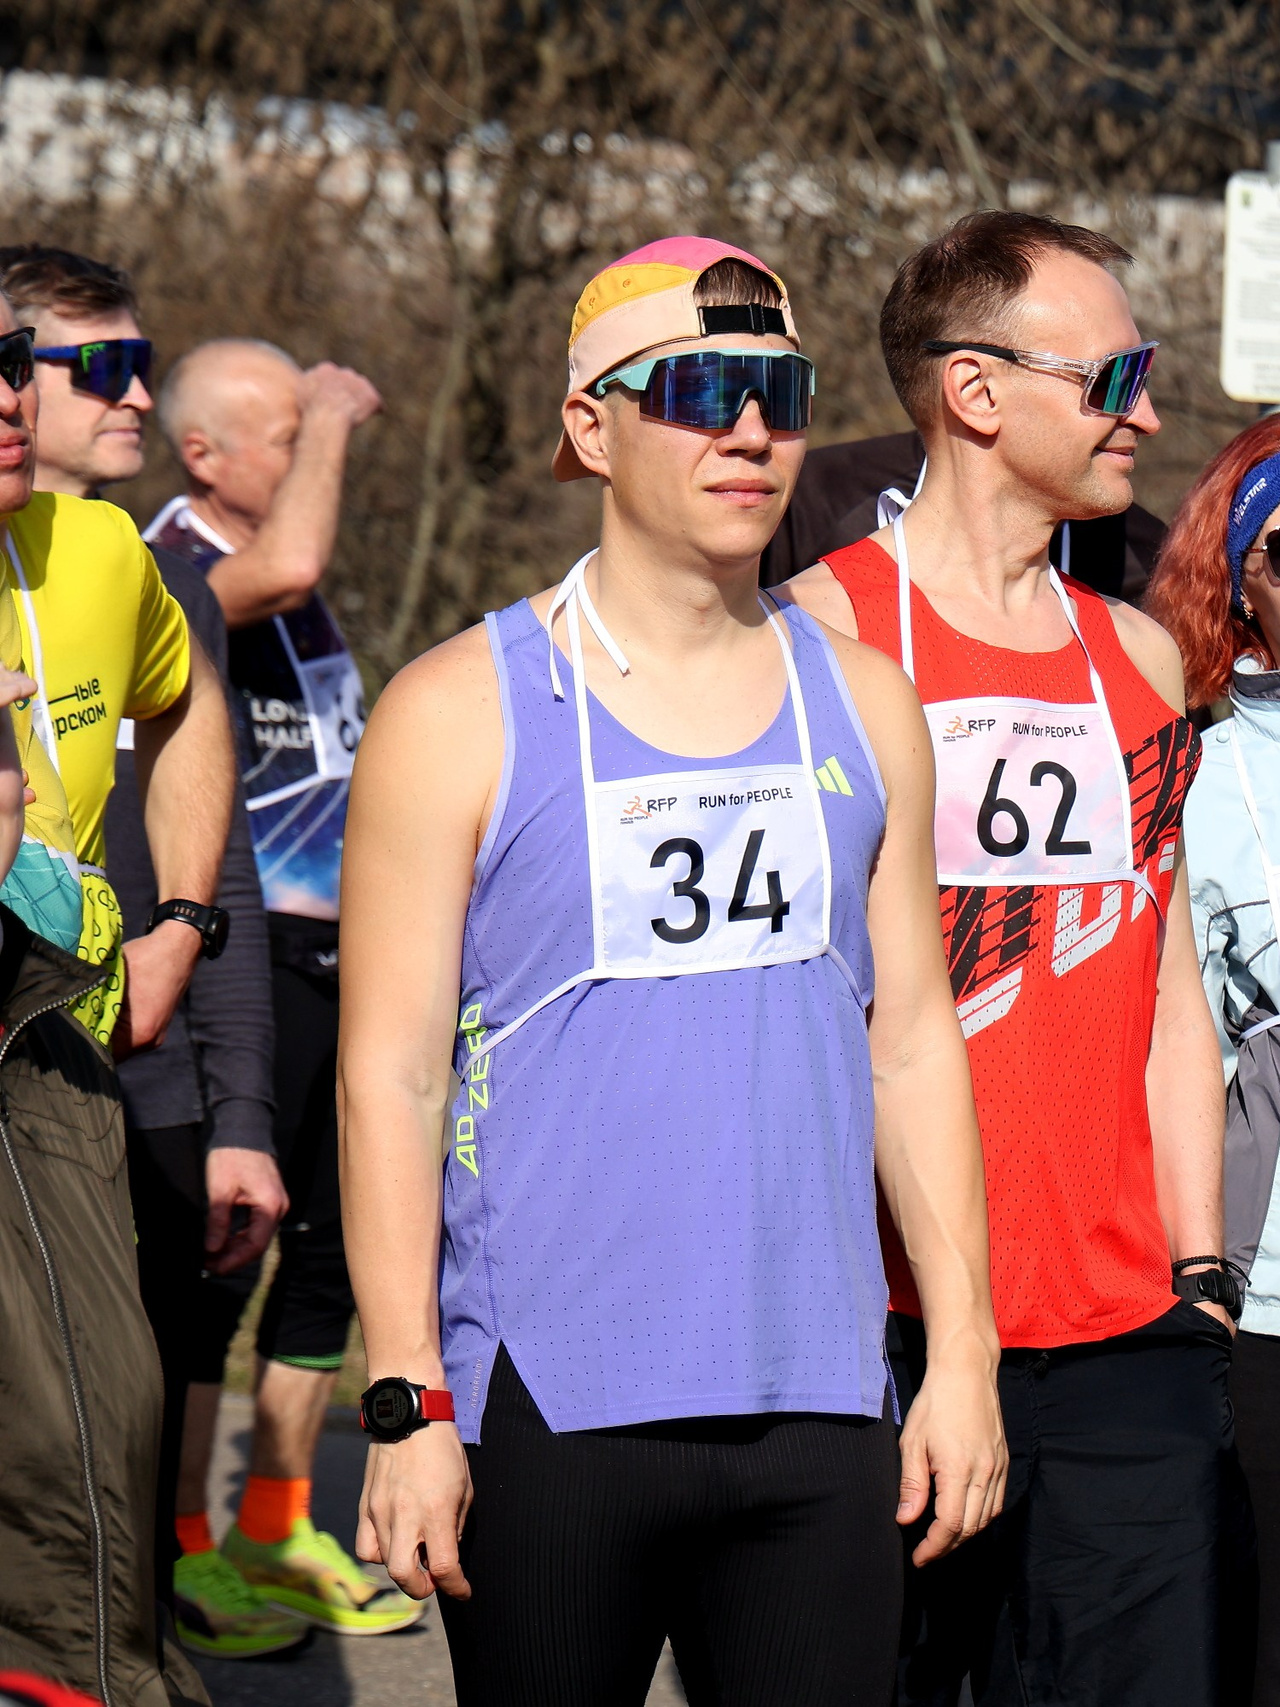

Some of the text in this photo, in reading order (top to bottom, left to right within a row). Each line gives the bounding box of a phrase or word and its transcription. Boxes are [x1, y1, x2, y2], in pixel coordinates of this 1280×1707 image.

[52, 702, 107, 741] рском
[968, 719, 996, 732] RFP
[1012, 722, 1088, 738] RUN for PEOPLE
[647, 797, 677, 812] RFP
[699, 787, 793, 809] RUN for PEOPLE
[977, 758, 1092, 857] 62
[650, 829, 790, 944] 34
[471, 1358, 482, 1408] AEROREADY
